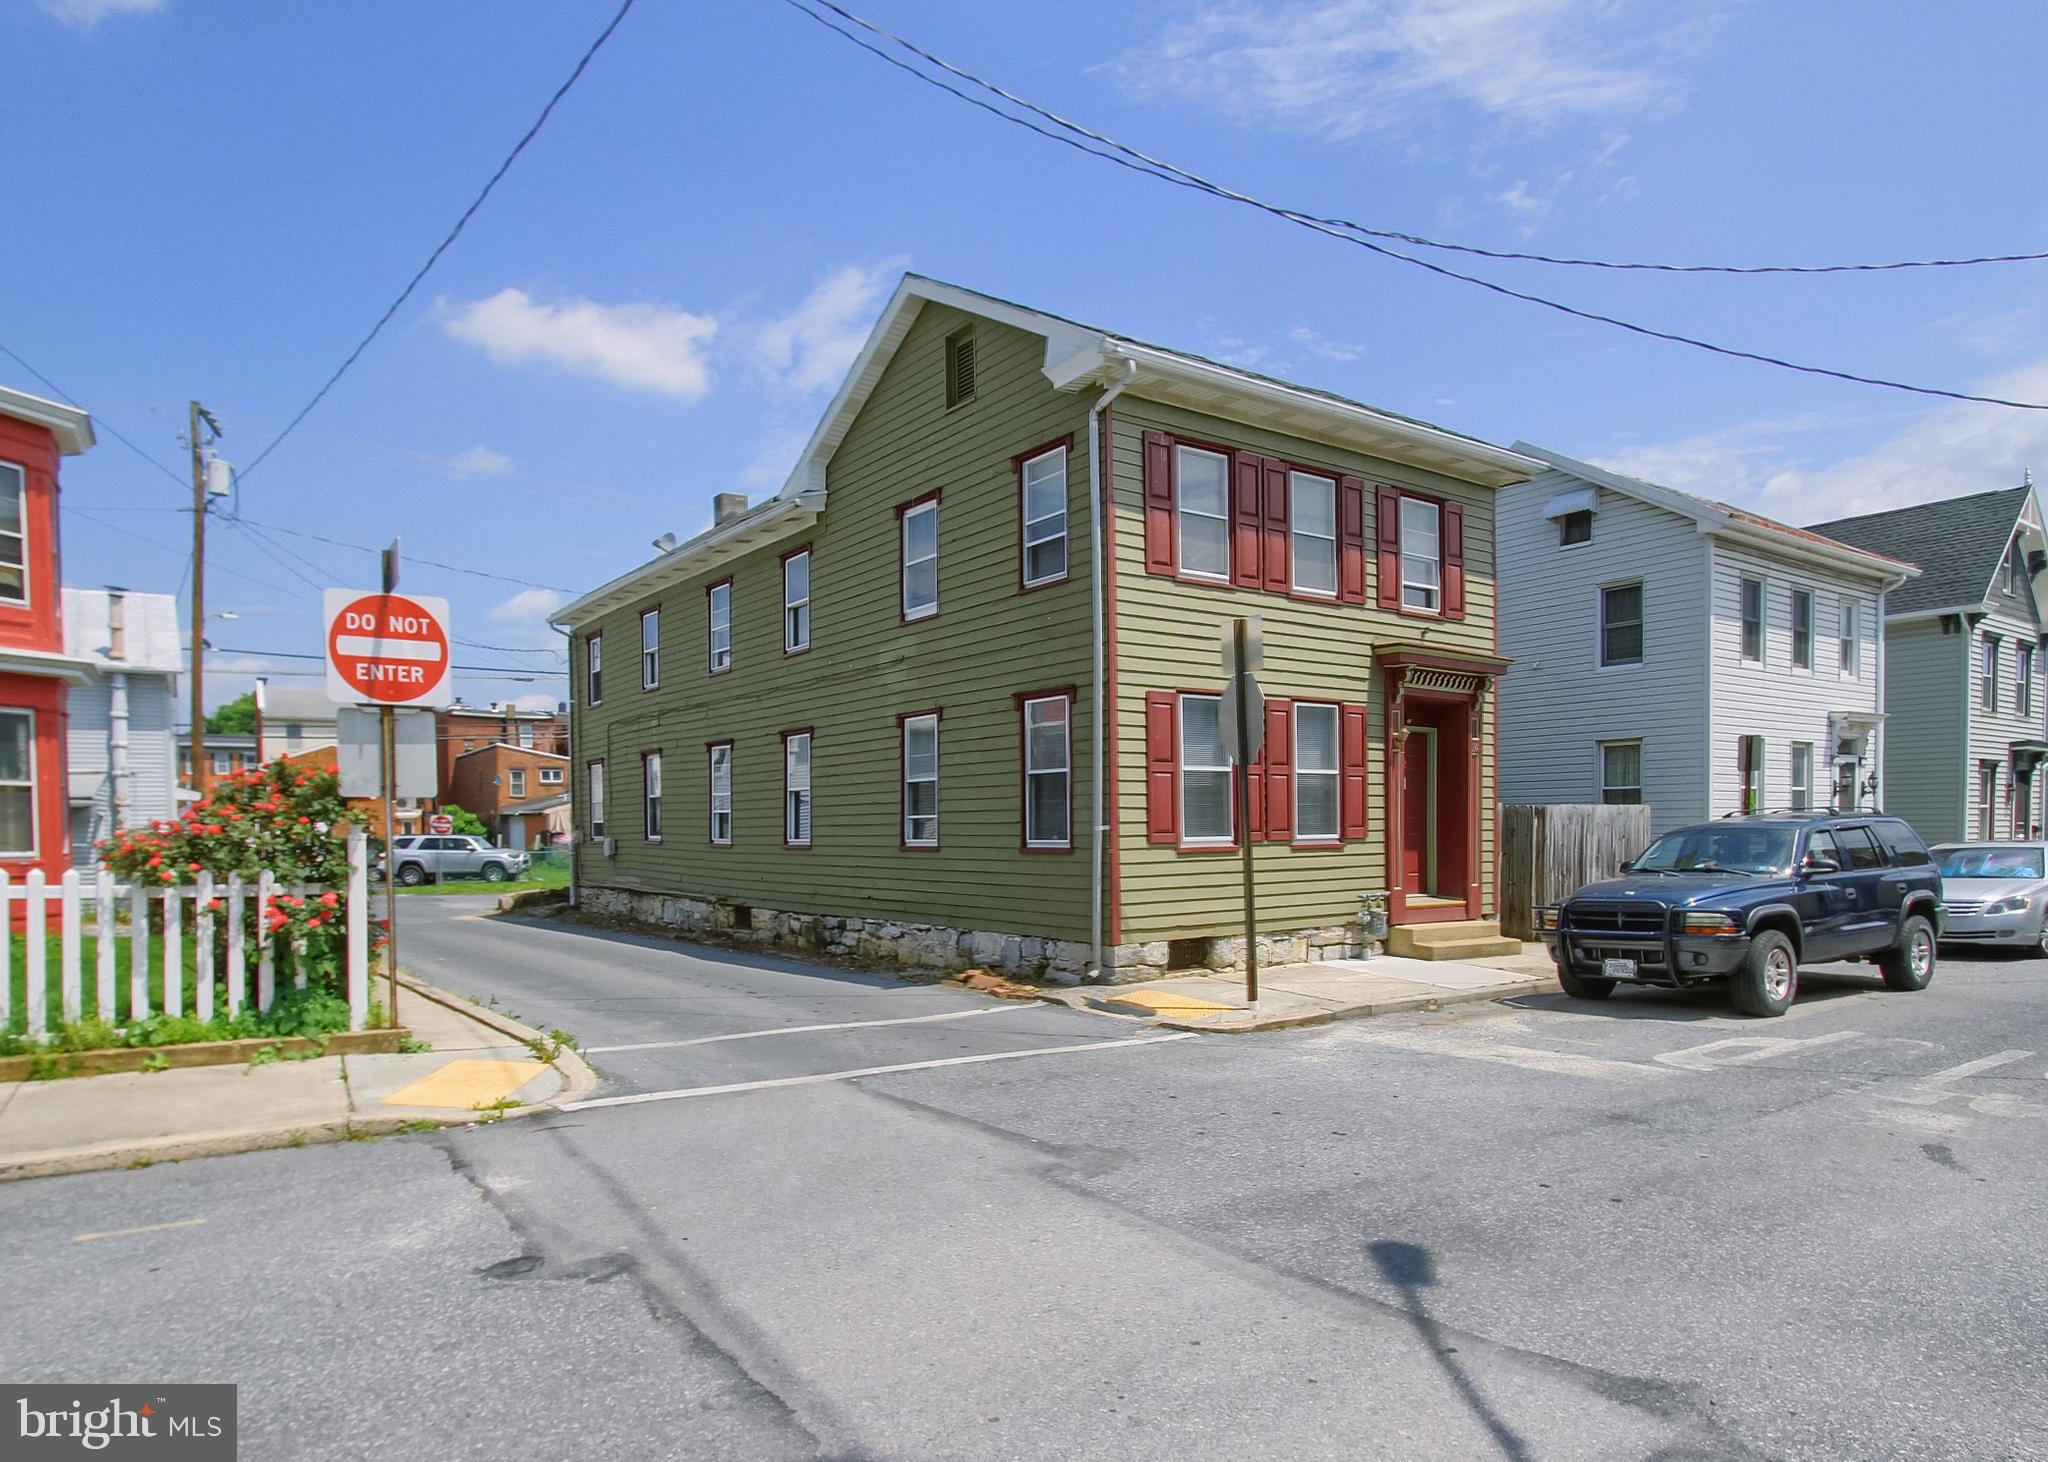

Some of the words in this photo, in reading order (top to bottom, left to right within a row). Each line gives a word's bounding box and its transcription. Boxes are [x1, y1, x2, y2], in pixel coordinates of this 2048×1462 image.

[345, 612, 376, 631] DO
[389, 616, 430, 635] NOT
[356, 662, 425, 683] ENTER
